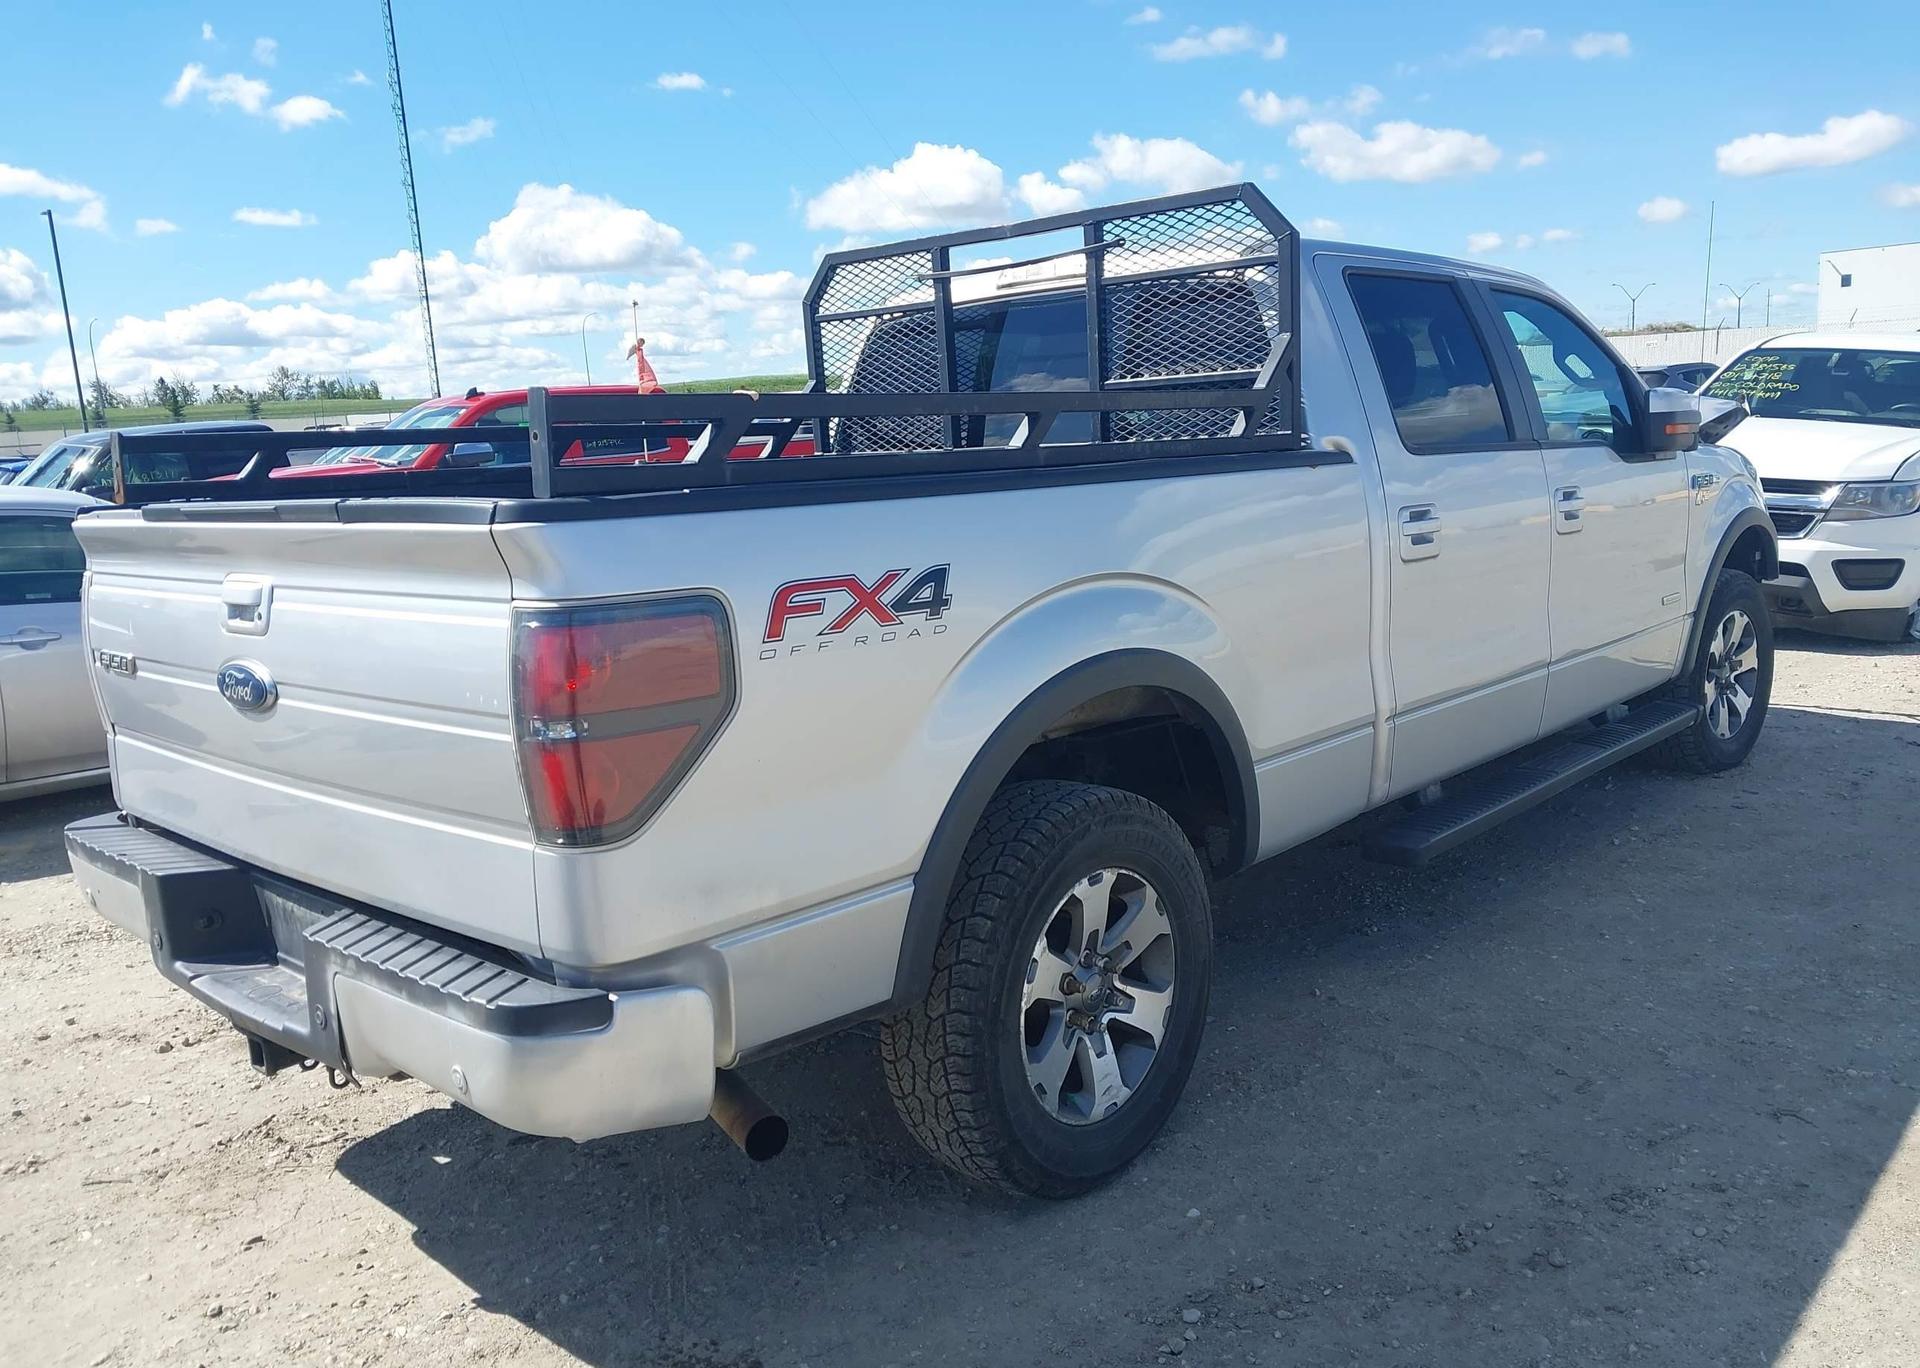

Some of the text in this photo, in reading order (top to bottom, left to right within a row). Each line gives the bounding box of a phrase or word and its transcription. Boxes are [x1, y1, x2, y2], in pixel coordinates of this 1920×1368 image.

[762, 563, 953, 643] FX4
[759, 624, 948, 660] OFF ROAD
[223, 670, 253, 702] Ford
